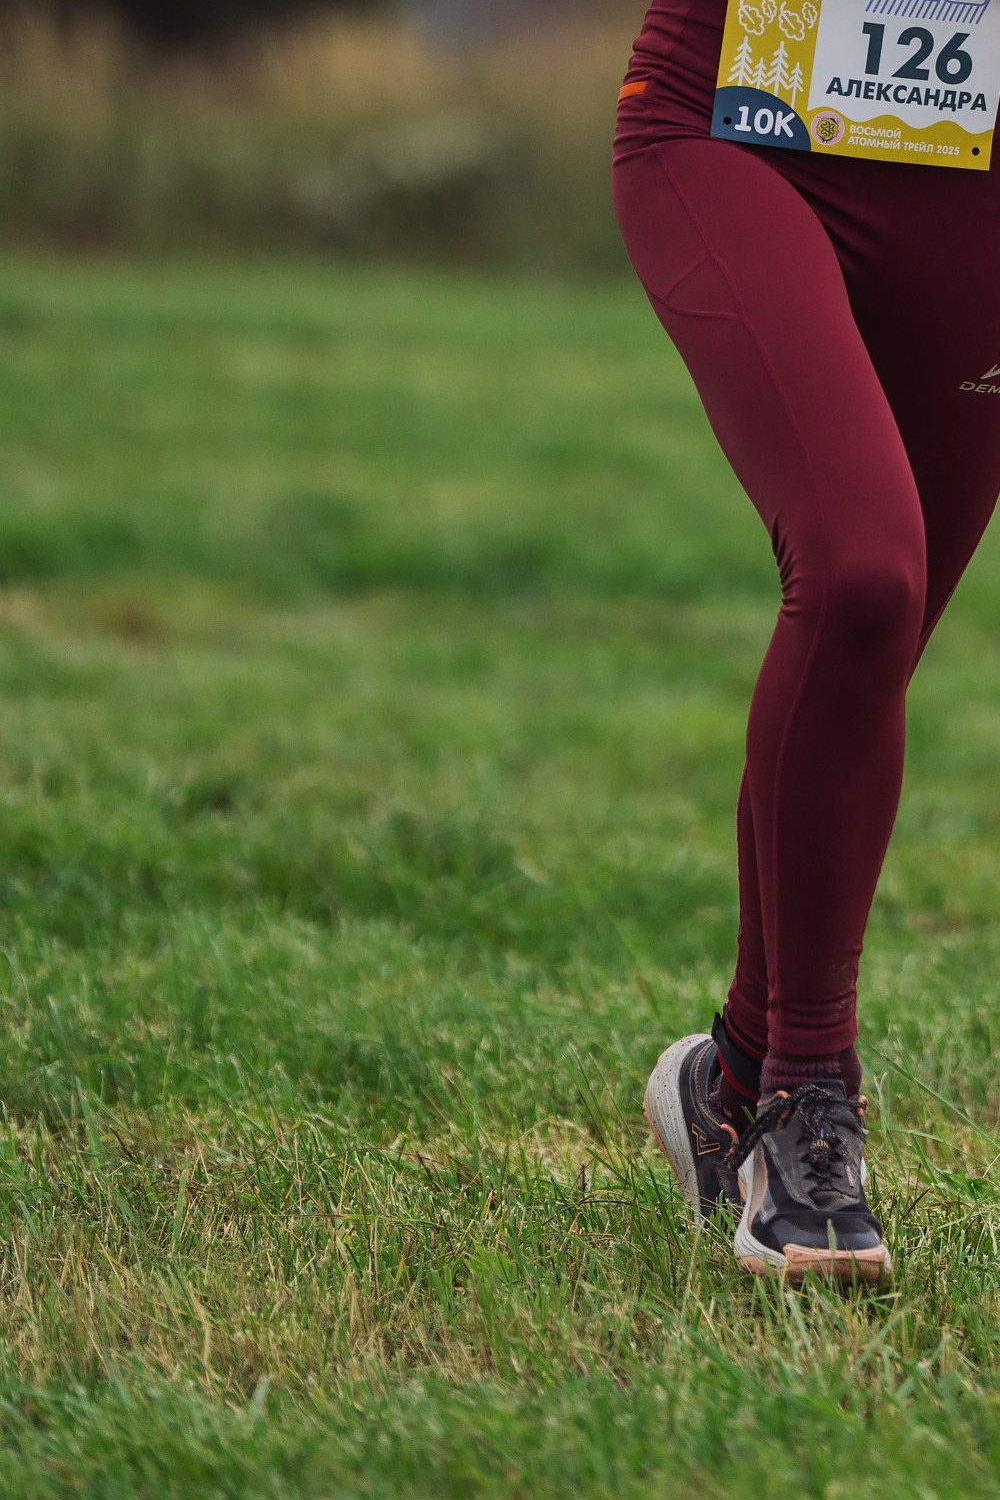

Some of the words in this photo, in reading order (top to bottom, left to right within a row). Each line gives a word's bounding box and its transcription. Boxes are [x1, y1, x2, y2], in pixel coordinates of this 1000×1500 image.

[862, 21, 973, 85] 126
[825, 76, 987, 112] АЛЕКСАНДРА
[847, 135, 901, 150] АТОМНЫЙ
[903, 141, 934, 153] ТРЕЙЛ
[936, 145, 960, 156] 2025
[849, 124, 902, 139] ВОСЬМОЙ
